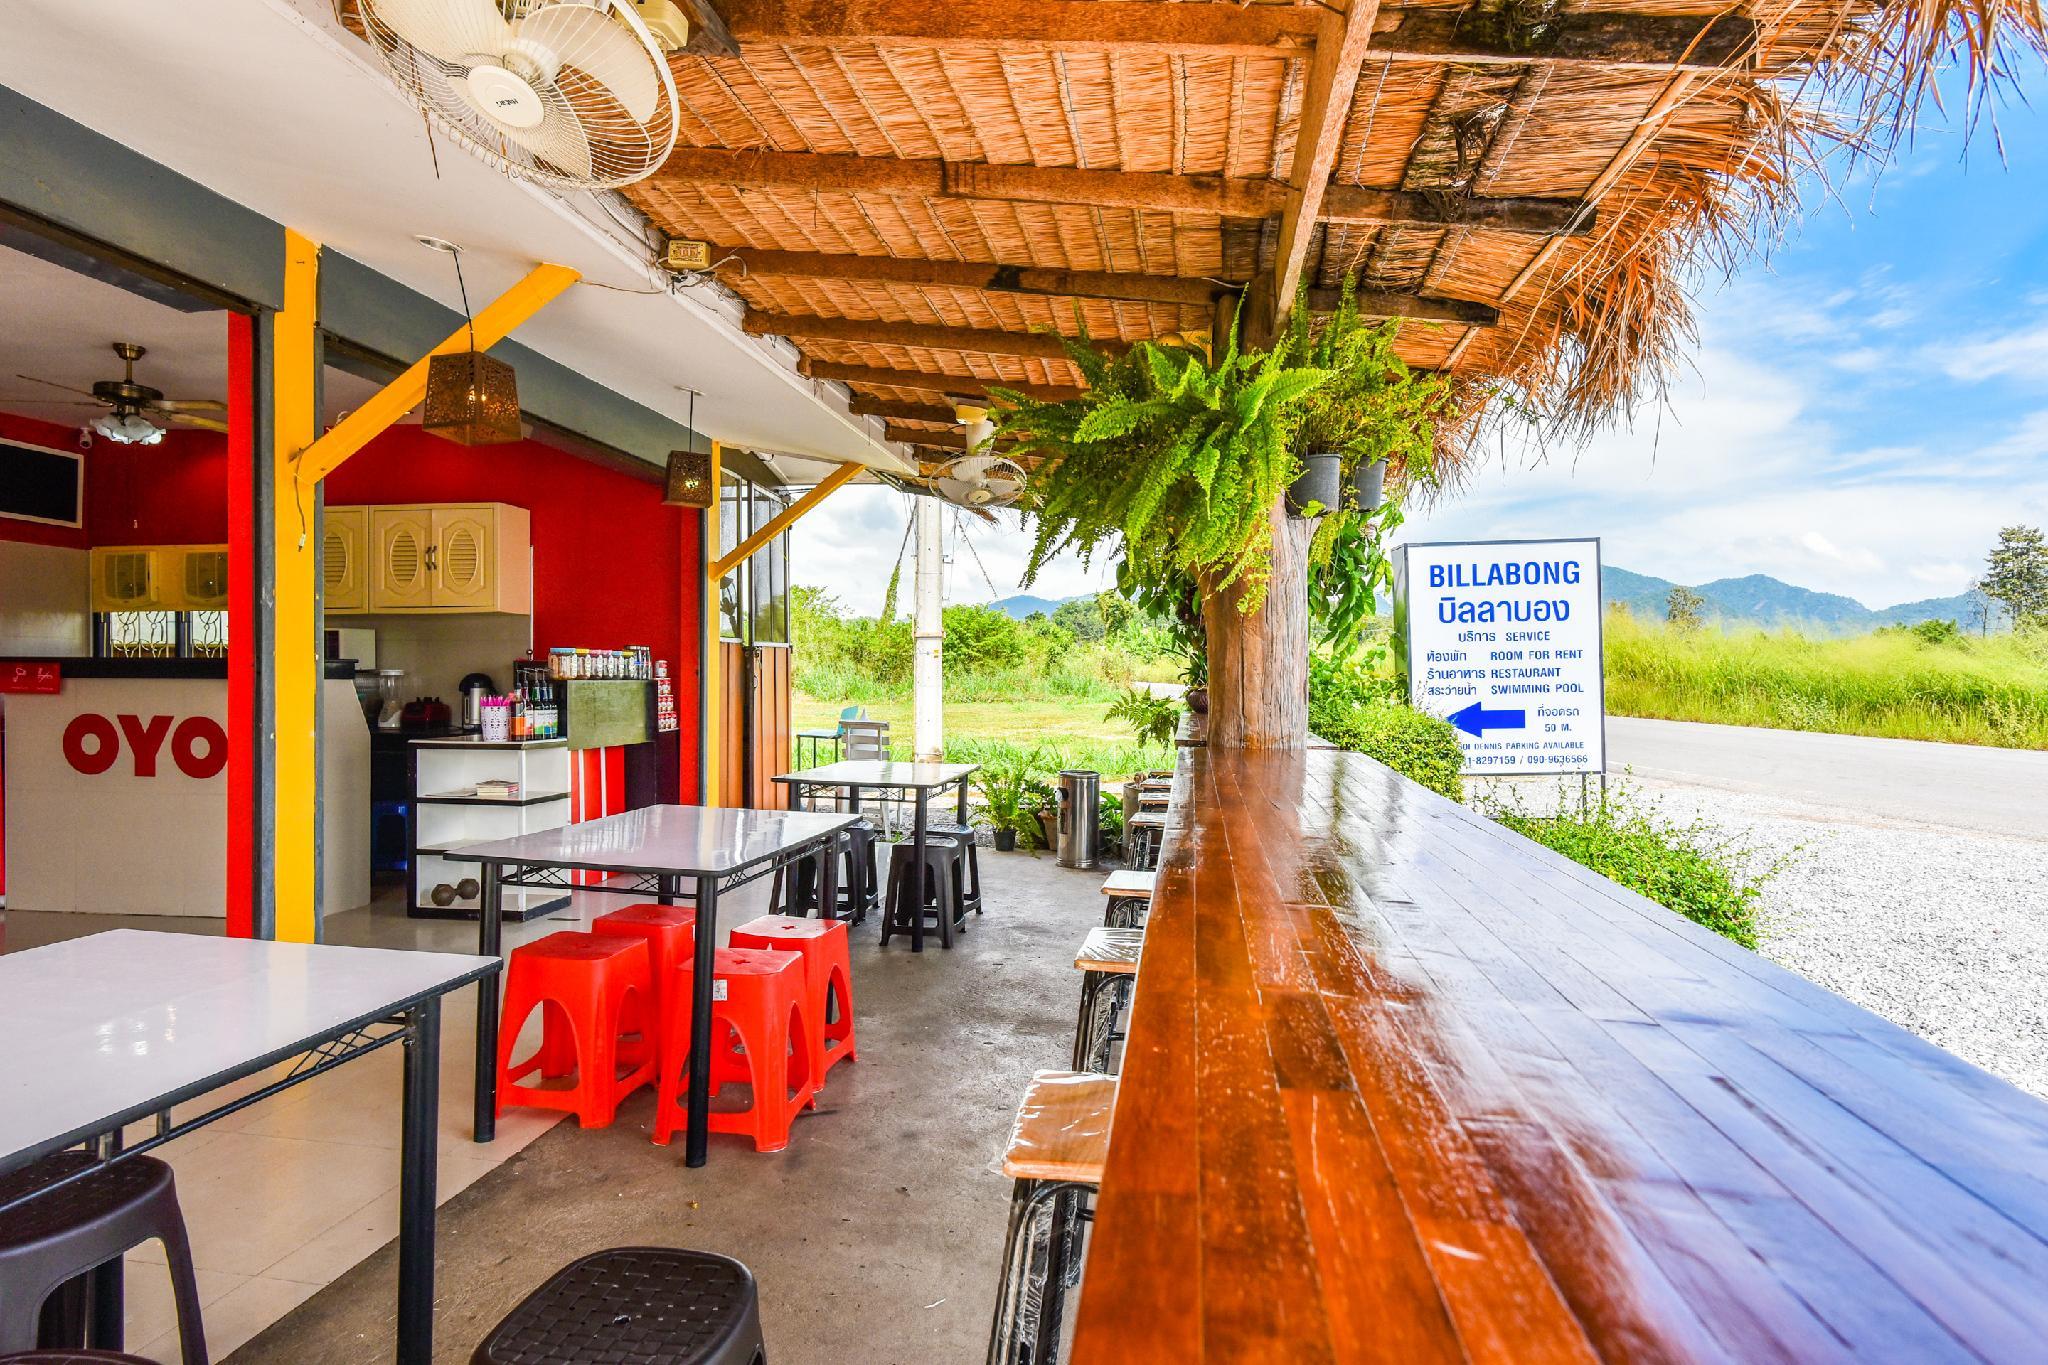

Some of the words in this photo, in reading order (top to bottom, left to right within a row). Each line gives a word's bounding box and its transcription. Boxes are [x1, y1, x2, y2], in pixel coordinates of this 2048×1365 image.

[1429, 560, 1580, 588] BILLABONG
[1438, 597, 1570, 623] บิลลาบอง
[1458, 630, 1496, 642] บริการ
[1505, 631, 1550, 642] SERVICE
[1427, 650, 1467, 662] ห้องพัก
[1490, 651, 1523, 661] ROOM
[1528, 650, 1550, 660] FOR
[1555, 650, 1583, 659] RENT
[1427, 667, 1486, 680] ร้านอาหาร
[1491, 667, 1561, 679] RESTAURANT
[1491, 684, 1550, 695] SWIMMING
[1555, 683, 1584, 693] POOL
[1544, 723, 1556, 733] 50
[62, 713, 228, 779] OYO
[1505, 742, 1540, 750] PARKING
[1543, 741, 1585, 749] AVAILABLE
